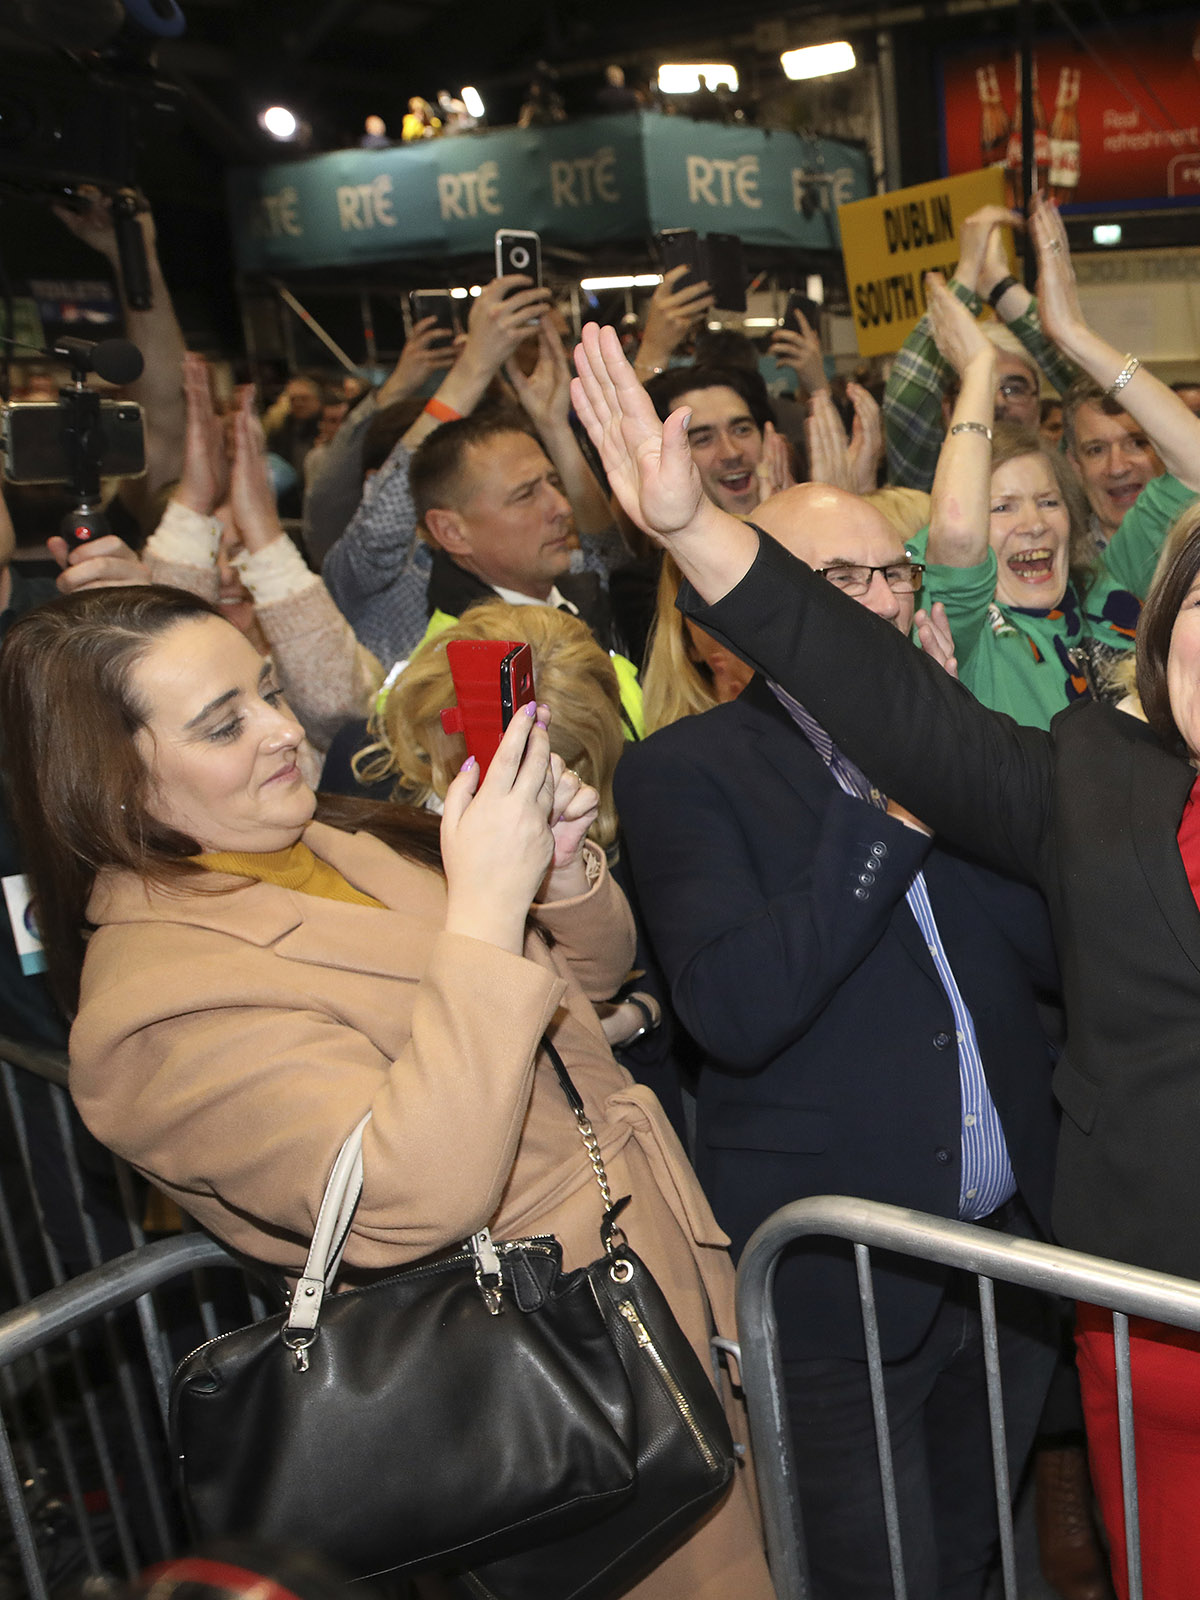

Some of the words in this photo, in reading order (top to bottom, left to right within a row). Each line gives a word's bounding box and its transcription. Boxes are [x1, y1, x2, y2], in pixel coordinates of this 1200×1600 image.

[1103, 109, 1140, 132] Real
[336, 173, 397, 232] RTÉ
[437, 160, 503, 220] RTÉ
[686, 154, 763, 209] RTÉ
[885, 194, 954, 255] DUBLIN
[857, 273, 918, 328] SOUTH
